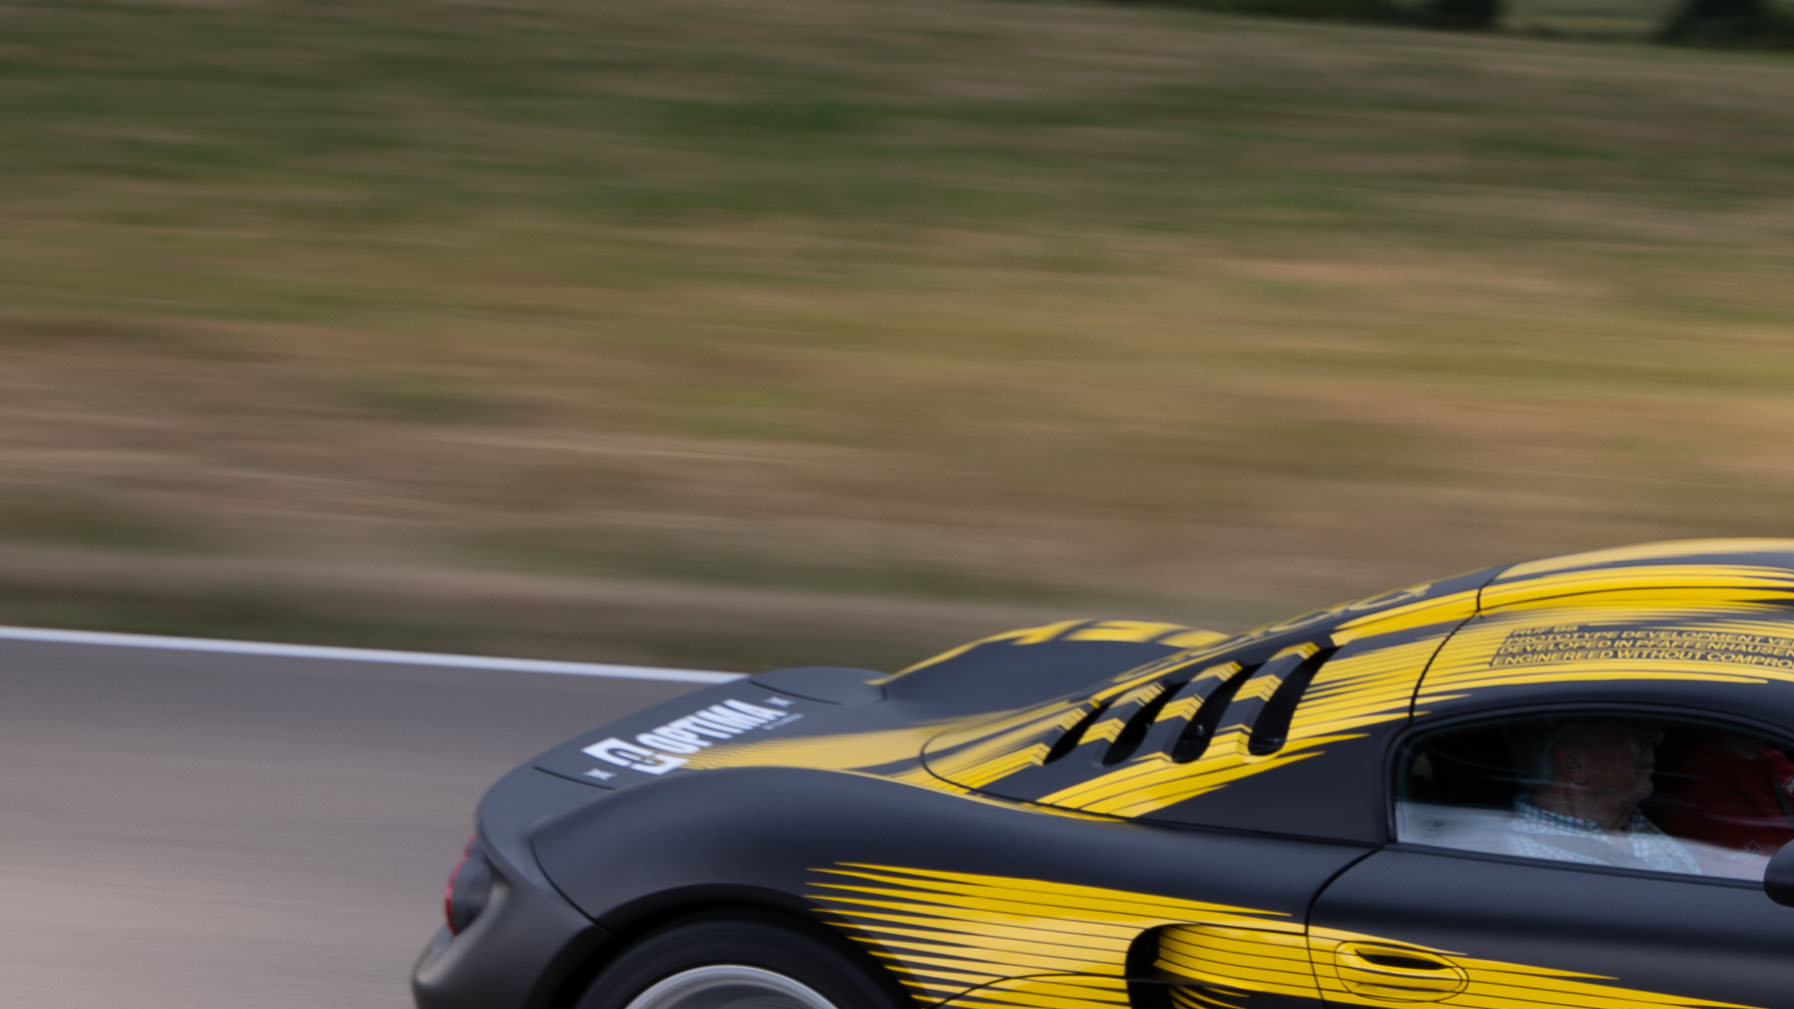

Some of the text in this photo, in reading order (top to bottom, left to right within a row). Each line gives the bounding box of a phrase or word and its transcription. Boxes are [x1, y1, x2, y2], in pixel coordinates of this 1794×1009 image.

[1506, 631, 1620, 645] PROTOTYPE
[1621, 631, 1766, 644] DEVELOPMENT
[1500, 640, 1611, 655] DEVELOPED
[1614, 638, 1632, 648] IN
[1617, 649, 1706, 660] WITHOUT
[635, 698, 788, 755] OPTIMA
